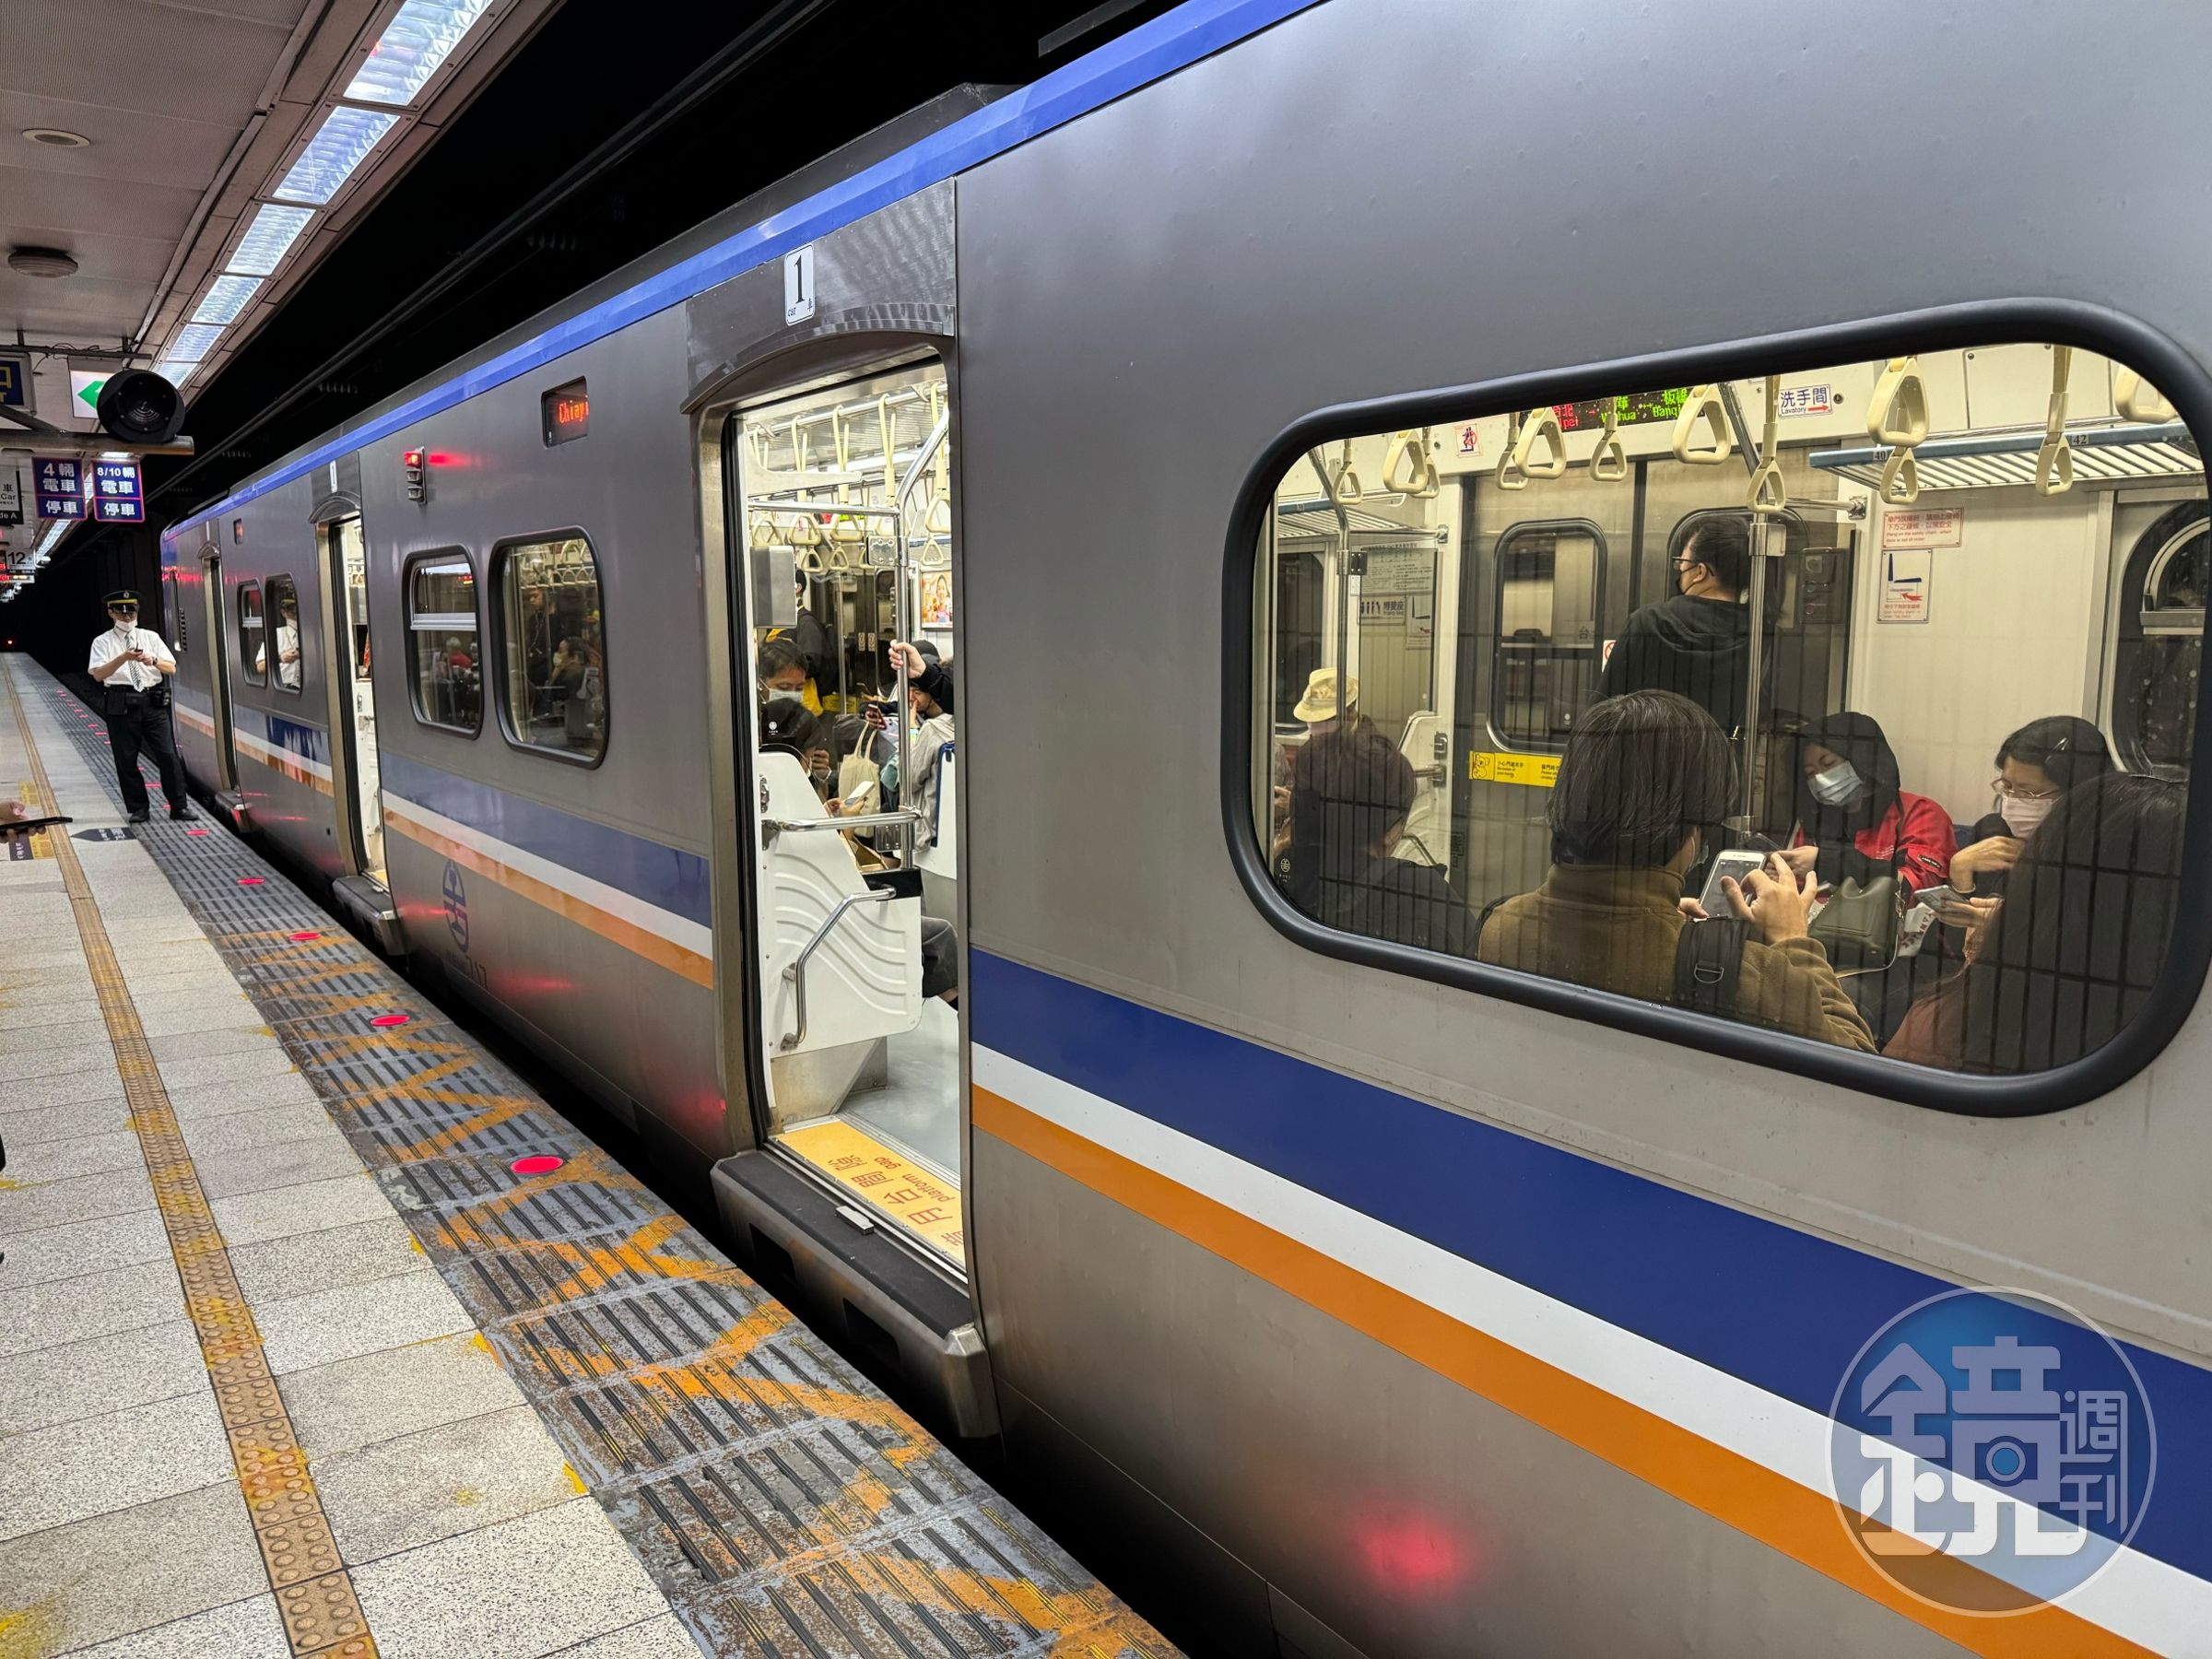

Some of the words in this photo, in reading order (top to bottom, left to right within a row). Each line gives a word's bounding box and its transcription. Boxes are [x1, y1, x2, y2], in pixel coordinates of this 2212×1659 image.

[794, 254, 805, 304] 1
[788, 307, 797, 317] car
[1617, 395, 1630, 409] 華
[1781, 387, 1828, 408] 洗手間
[1601, 411, 1637, 423] Whua
[1782, 406, 1806, 415] Lavatory
[2073, 434, 2087, 445] 42
[1874, 451, 1887, 461] 40
[42, 477, 76, 492] 電車
[100, 479, 134, 494] 電車
[45, 500, 78, 514] 停車
[104, 502, 135, 516] 停車
[7, 551, 26, 565] 12
[874, 1156, 902, 1170] gap
[901, 1173, 956, 1203] platform
